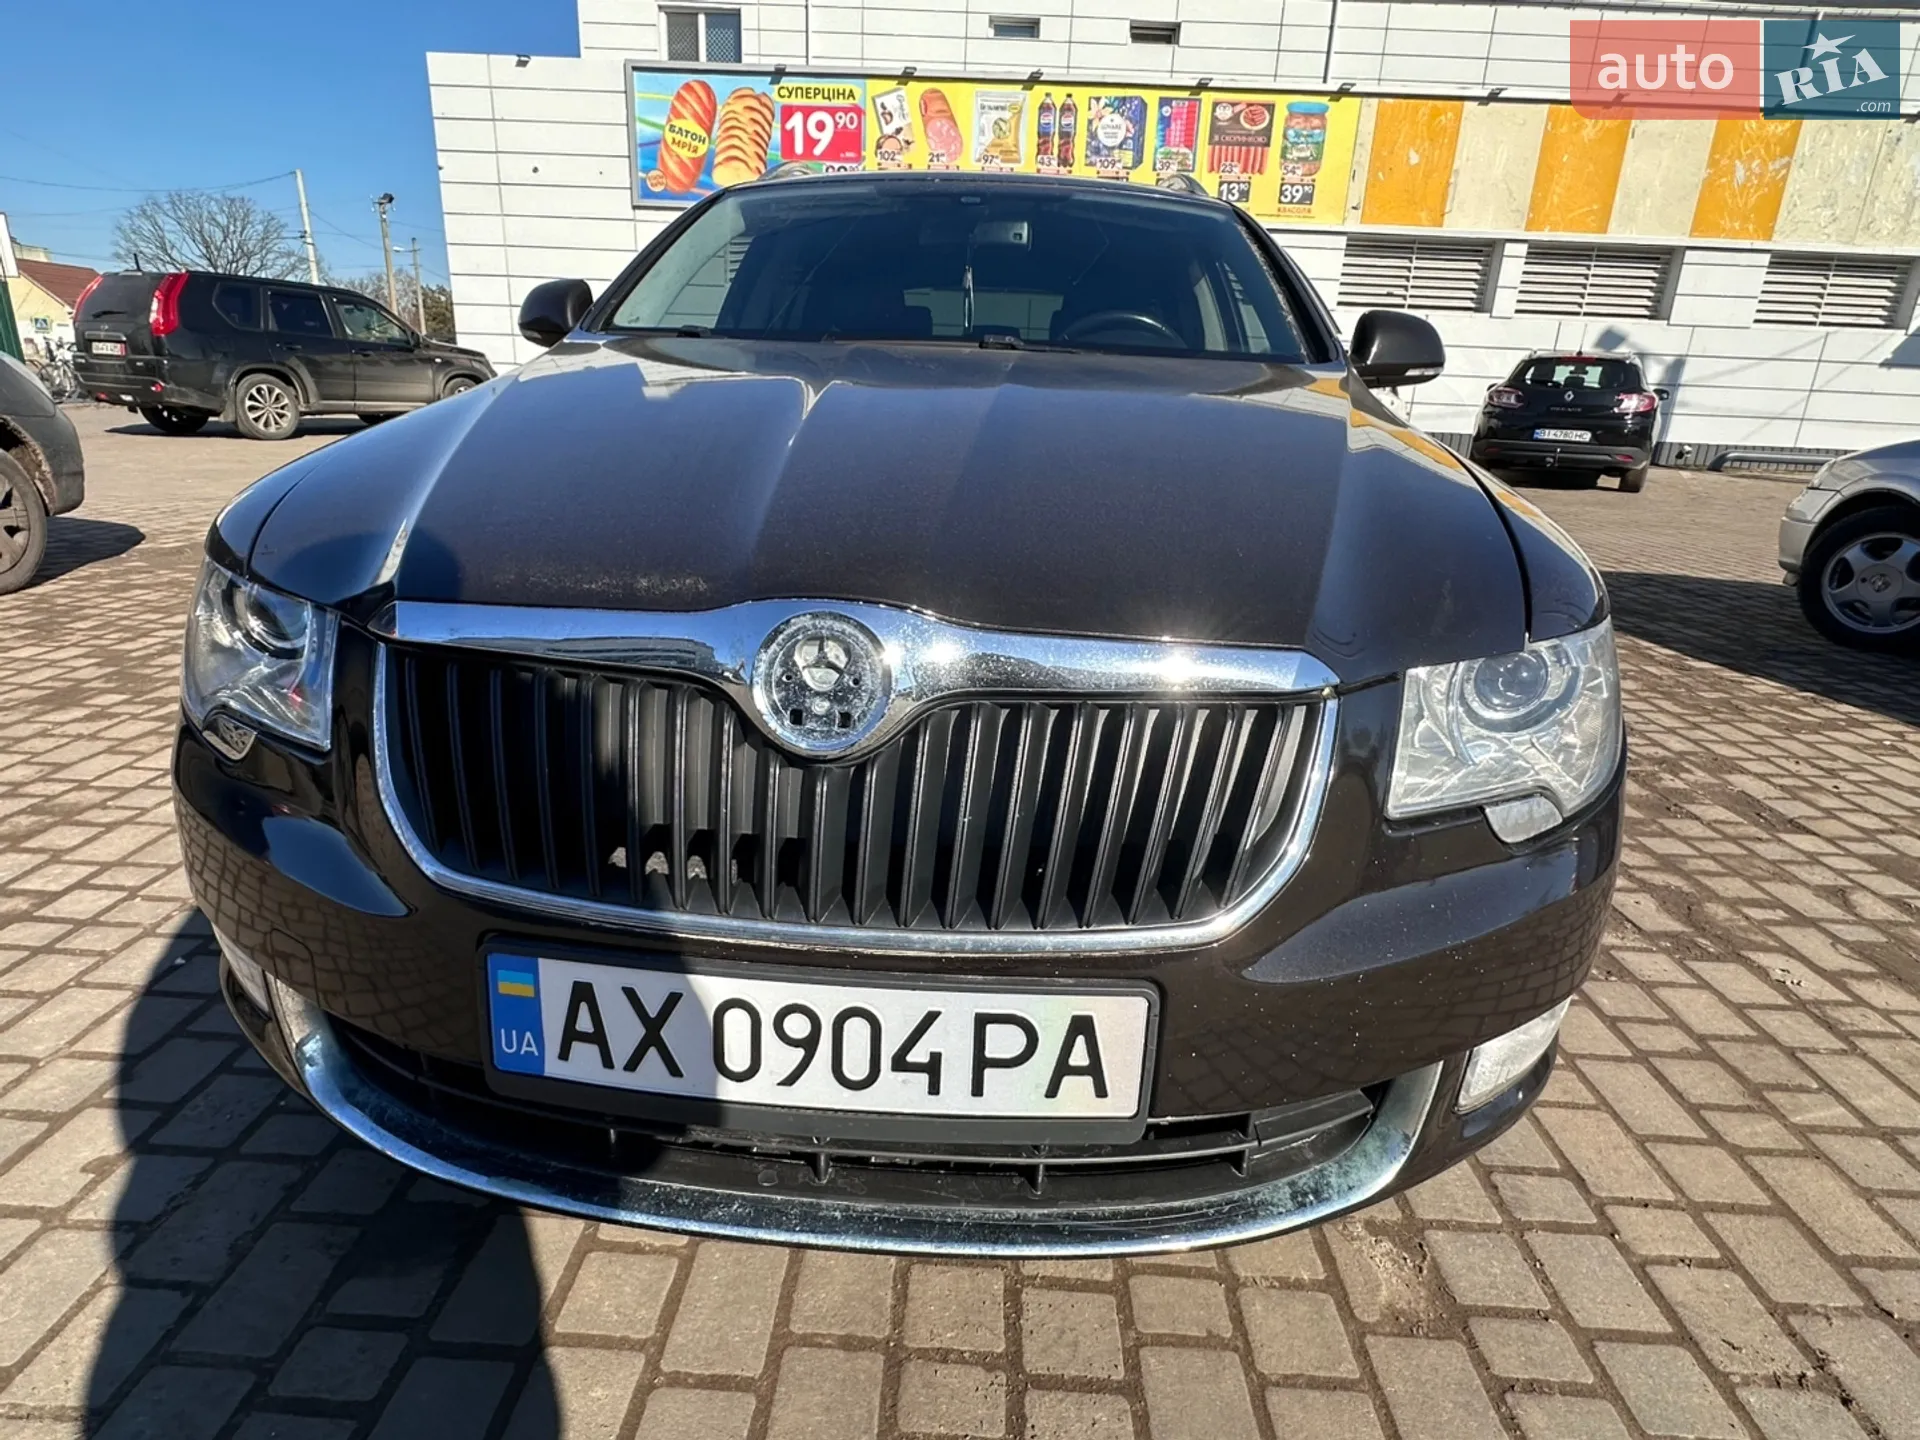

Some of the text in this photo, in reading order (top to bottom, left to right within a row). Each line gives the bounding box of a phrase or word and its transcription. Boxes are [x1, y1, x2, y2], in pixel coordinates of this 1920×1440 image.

[777, 85, 856, 101] СУПЕРЦІНА
[668, 124, 706, 145] БАТОН
[784, 110, 858, 156] 19 90
[671, 136, 699, 154] МРІЯ
[1219, 183, 1240, 201] 13
[1280, 185, 1303, 203] 39
[500, 1028, 538, 1057] UA
[558, 980, 1109, 1099] AX 0904 PA
